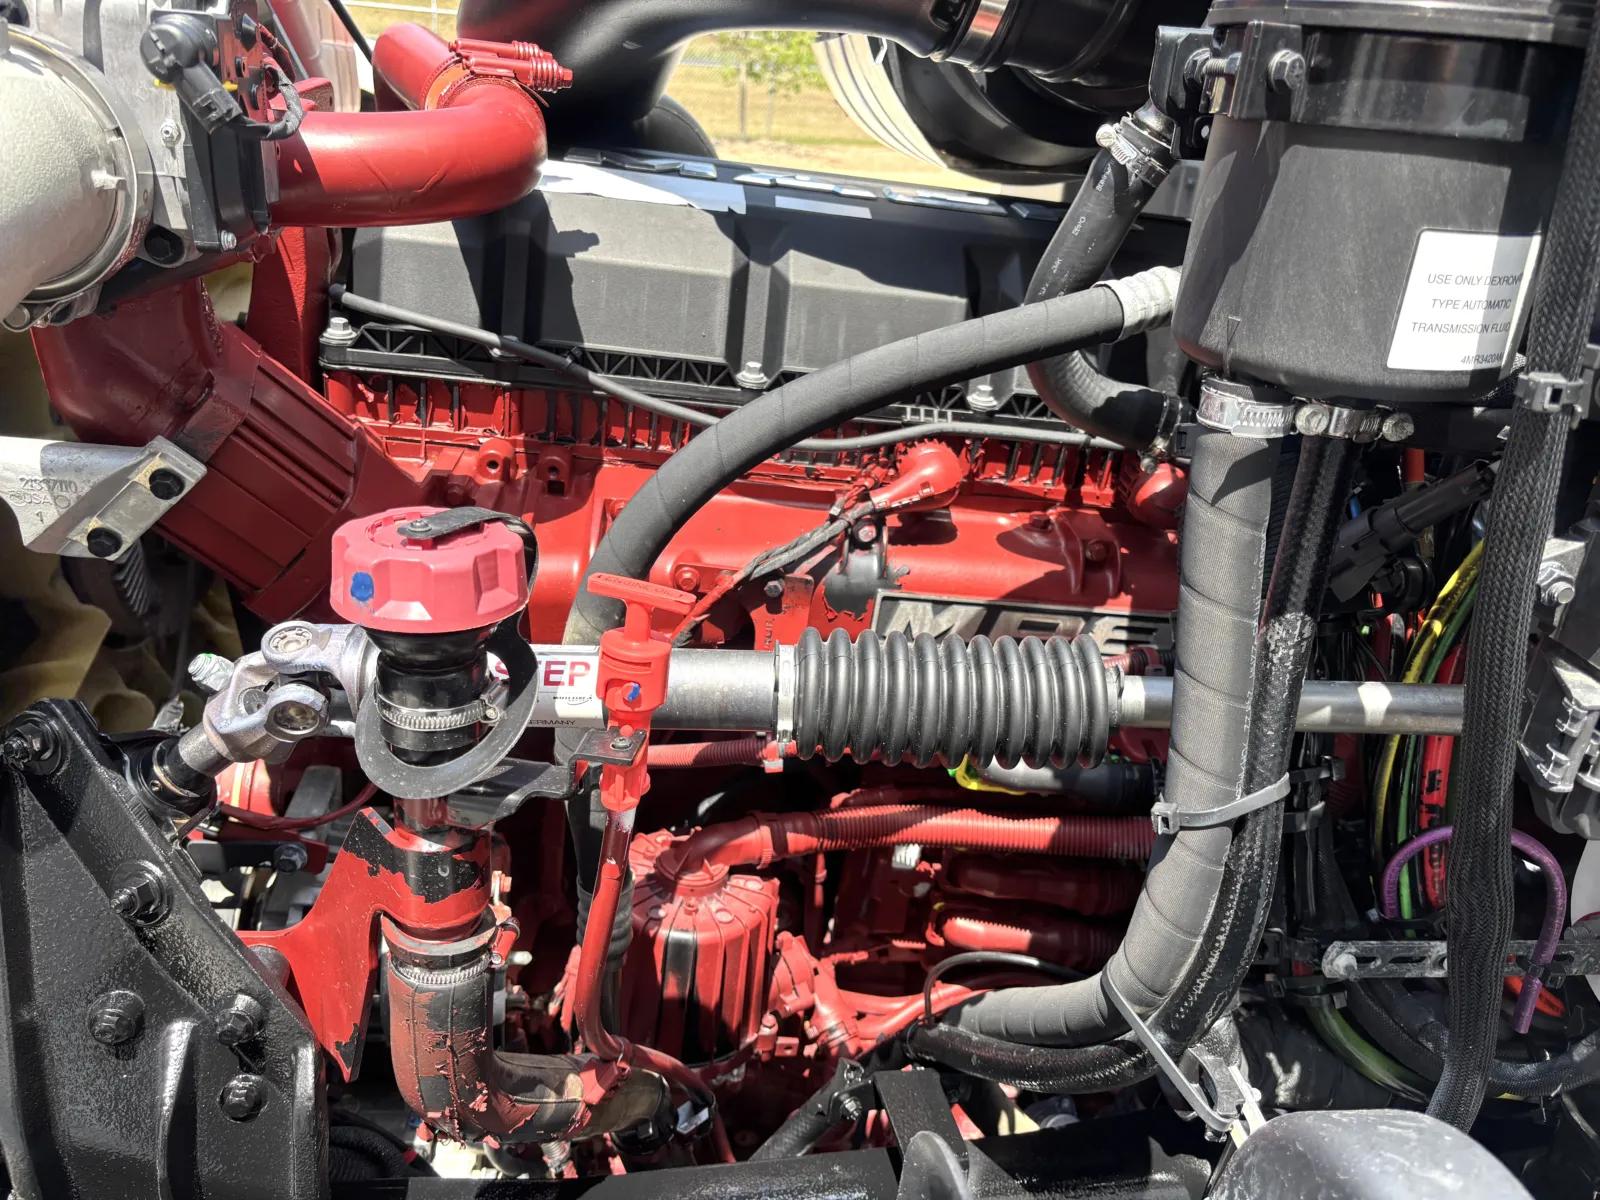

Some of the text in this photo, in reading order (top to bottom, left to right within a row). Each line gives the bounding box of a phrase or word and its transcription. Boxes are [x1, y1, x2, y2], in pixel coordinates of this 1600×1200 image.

[1427, 273, 1453, 285] USE
[1455, 274, 1483, 286] ONLY
[1431, 298, 1512, 310] TYPE AUTOMATIC
[1412, 322, 1511, 334] TRANSMISSION FLUID
[24, 491, 53, 505] USA
